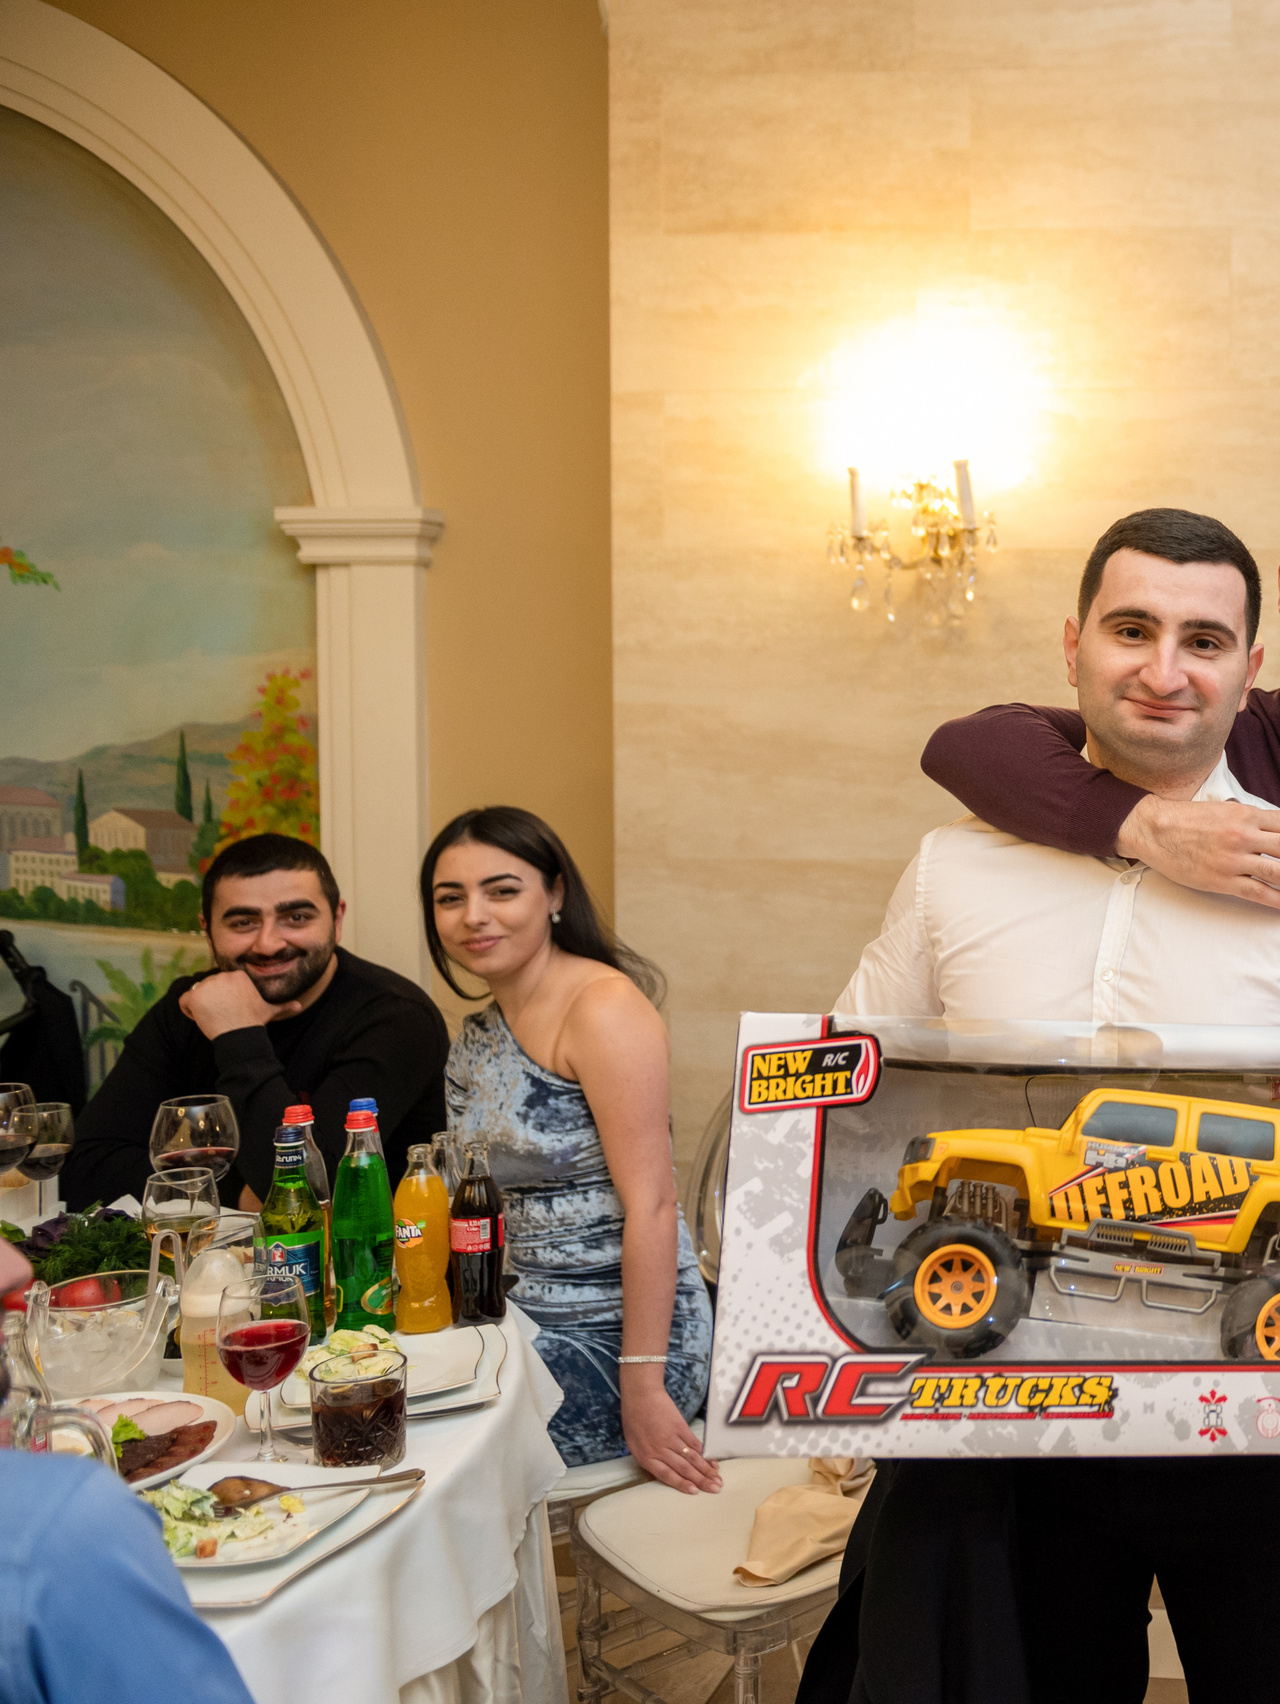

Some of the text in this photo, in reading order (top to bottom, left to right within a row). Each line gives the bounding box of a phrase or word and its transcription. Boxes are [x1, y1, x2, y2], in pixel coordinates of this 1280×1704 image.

[752, 1050, 849, 1078] NEW R/C
[750, 1071, 851, 1103] BRIGHT
[1052, 1153, 1250, 1223] OFFROAD
[395, 1225, 422, 1238] FANTA
[1115, 1264, 1162, 1274] NEW BRIGHT
[730, 1354, 930, 1424] RC
[910, 1376, 1113, 1408] TRUCKS
